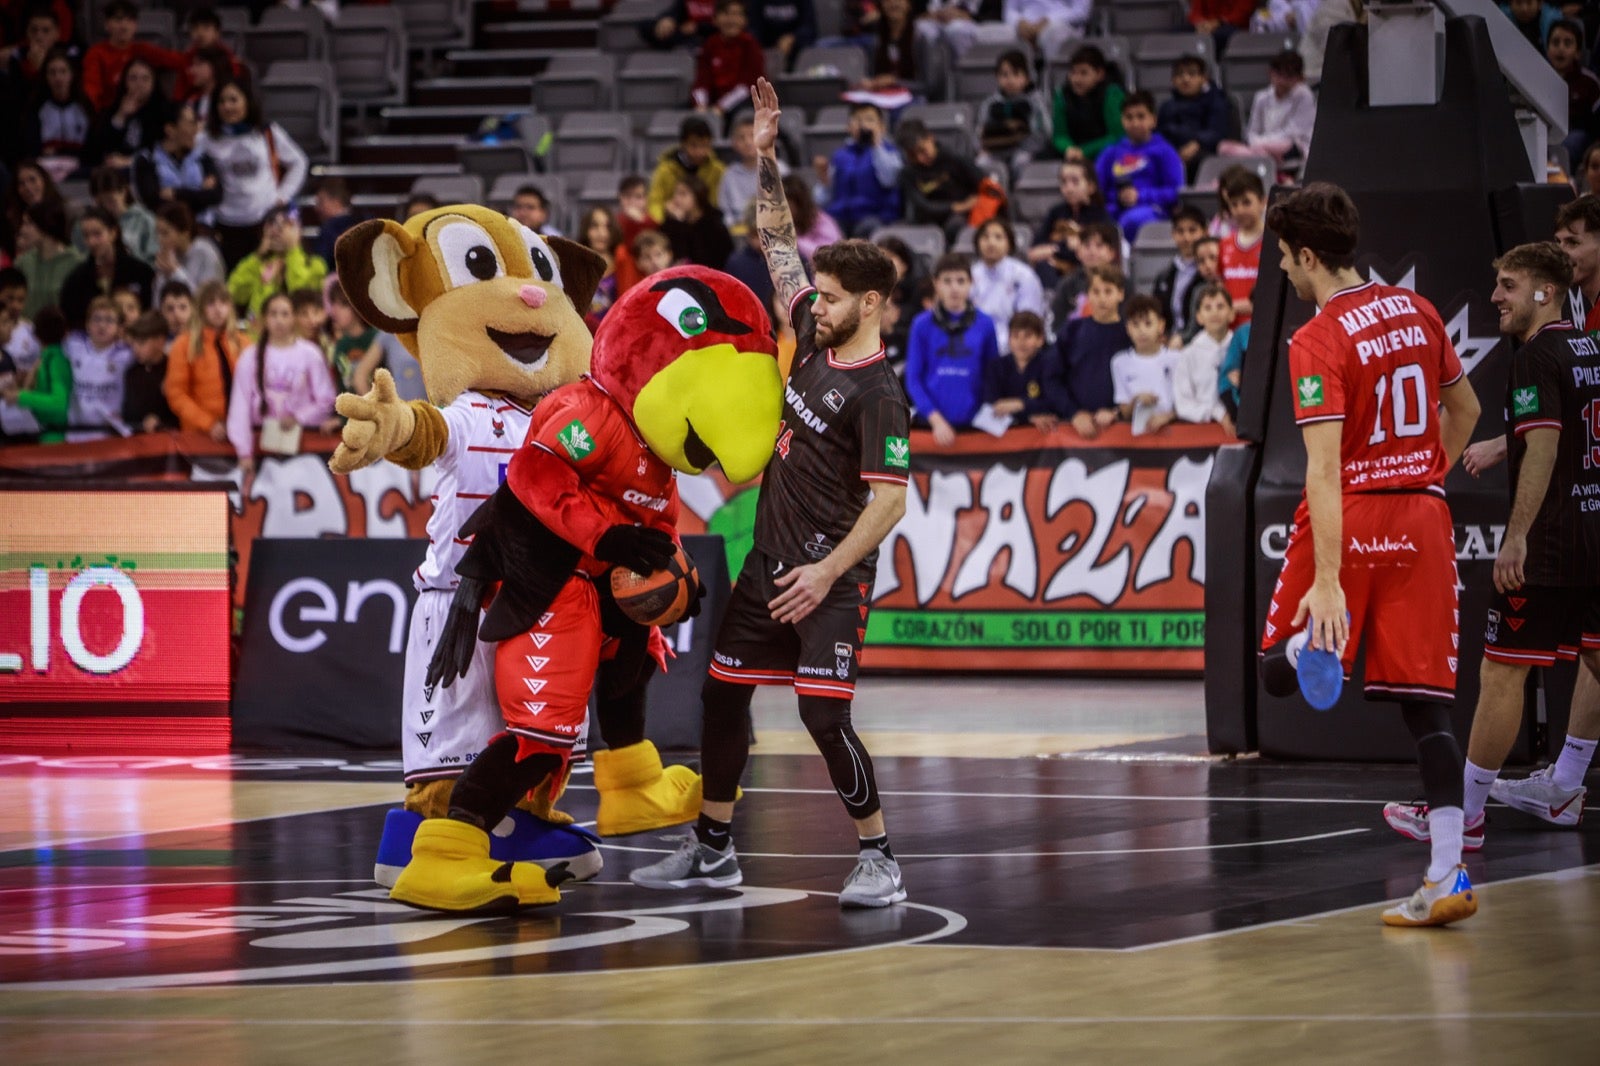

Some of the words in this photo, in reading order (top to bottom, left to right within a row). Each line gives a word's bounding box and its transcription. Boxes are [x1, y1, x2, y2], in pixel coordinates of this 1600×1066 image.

[1337, 295, 1418, 337] MARTÍNEZ
[1355, 325, 1428, 366] PULEVA
[1368, 362, 1428, 446] 10
[1011, 618, 1072, 642] SOLO
[1079, 618, 1121, 642] POR
[1161, 618, 1205, 641] POR
[439, 756, 460, 764] vive
